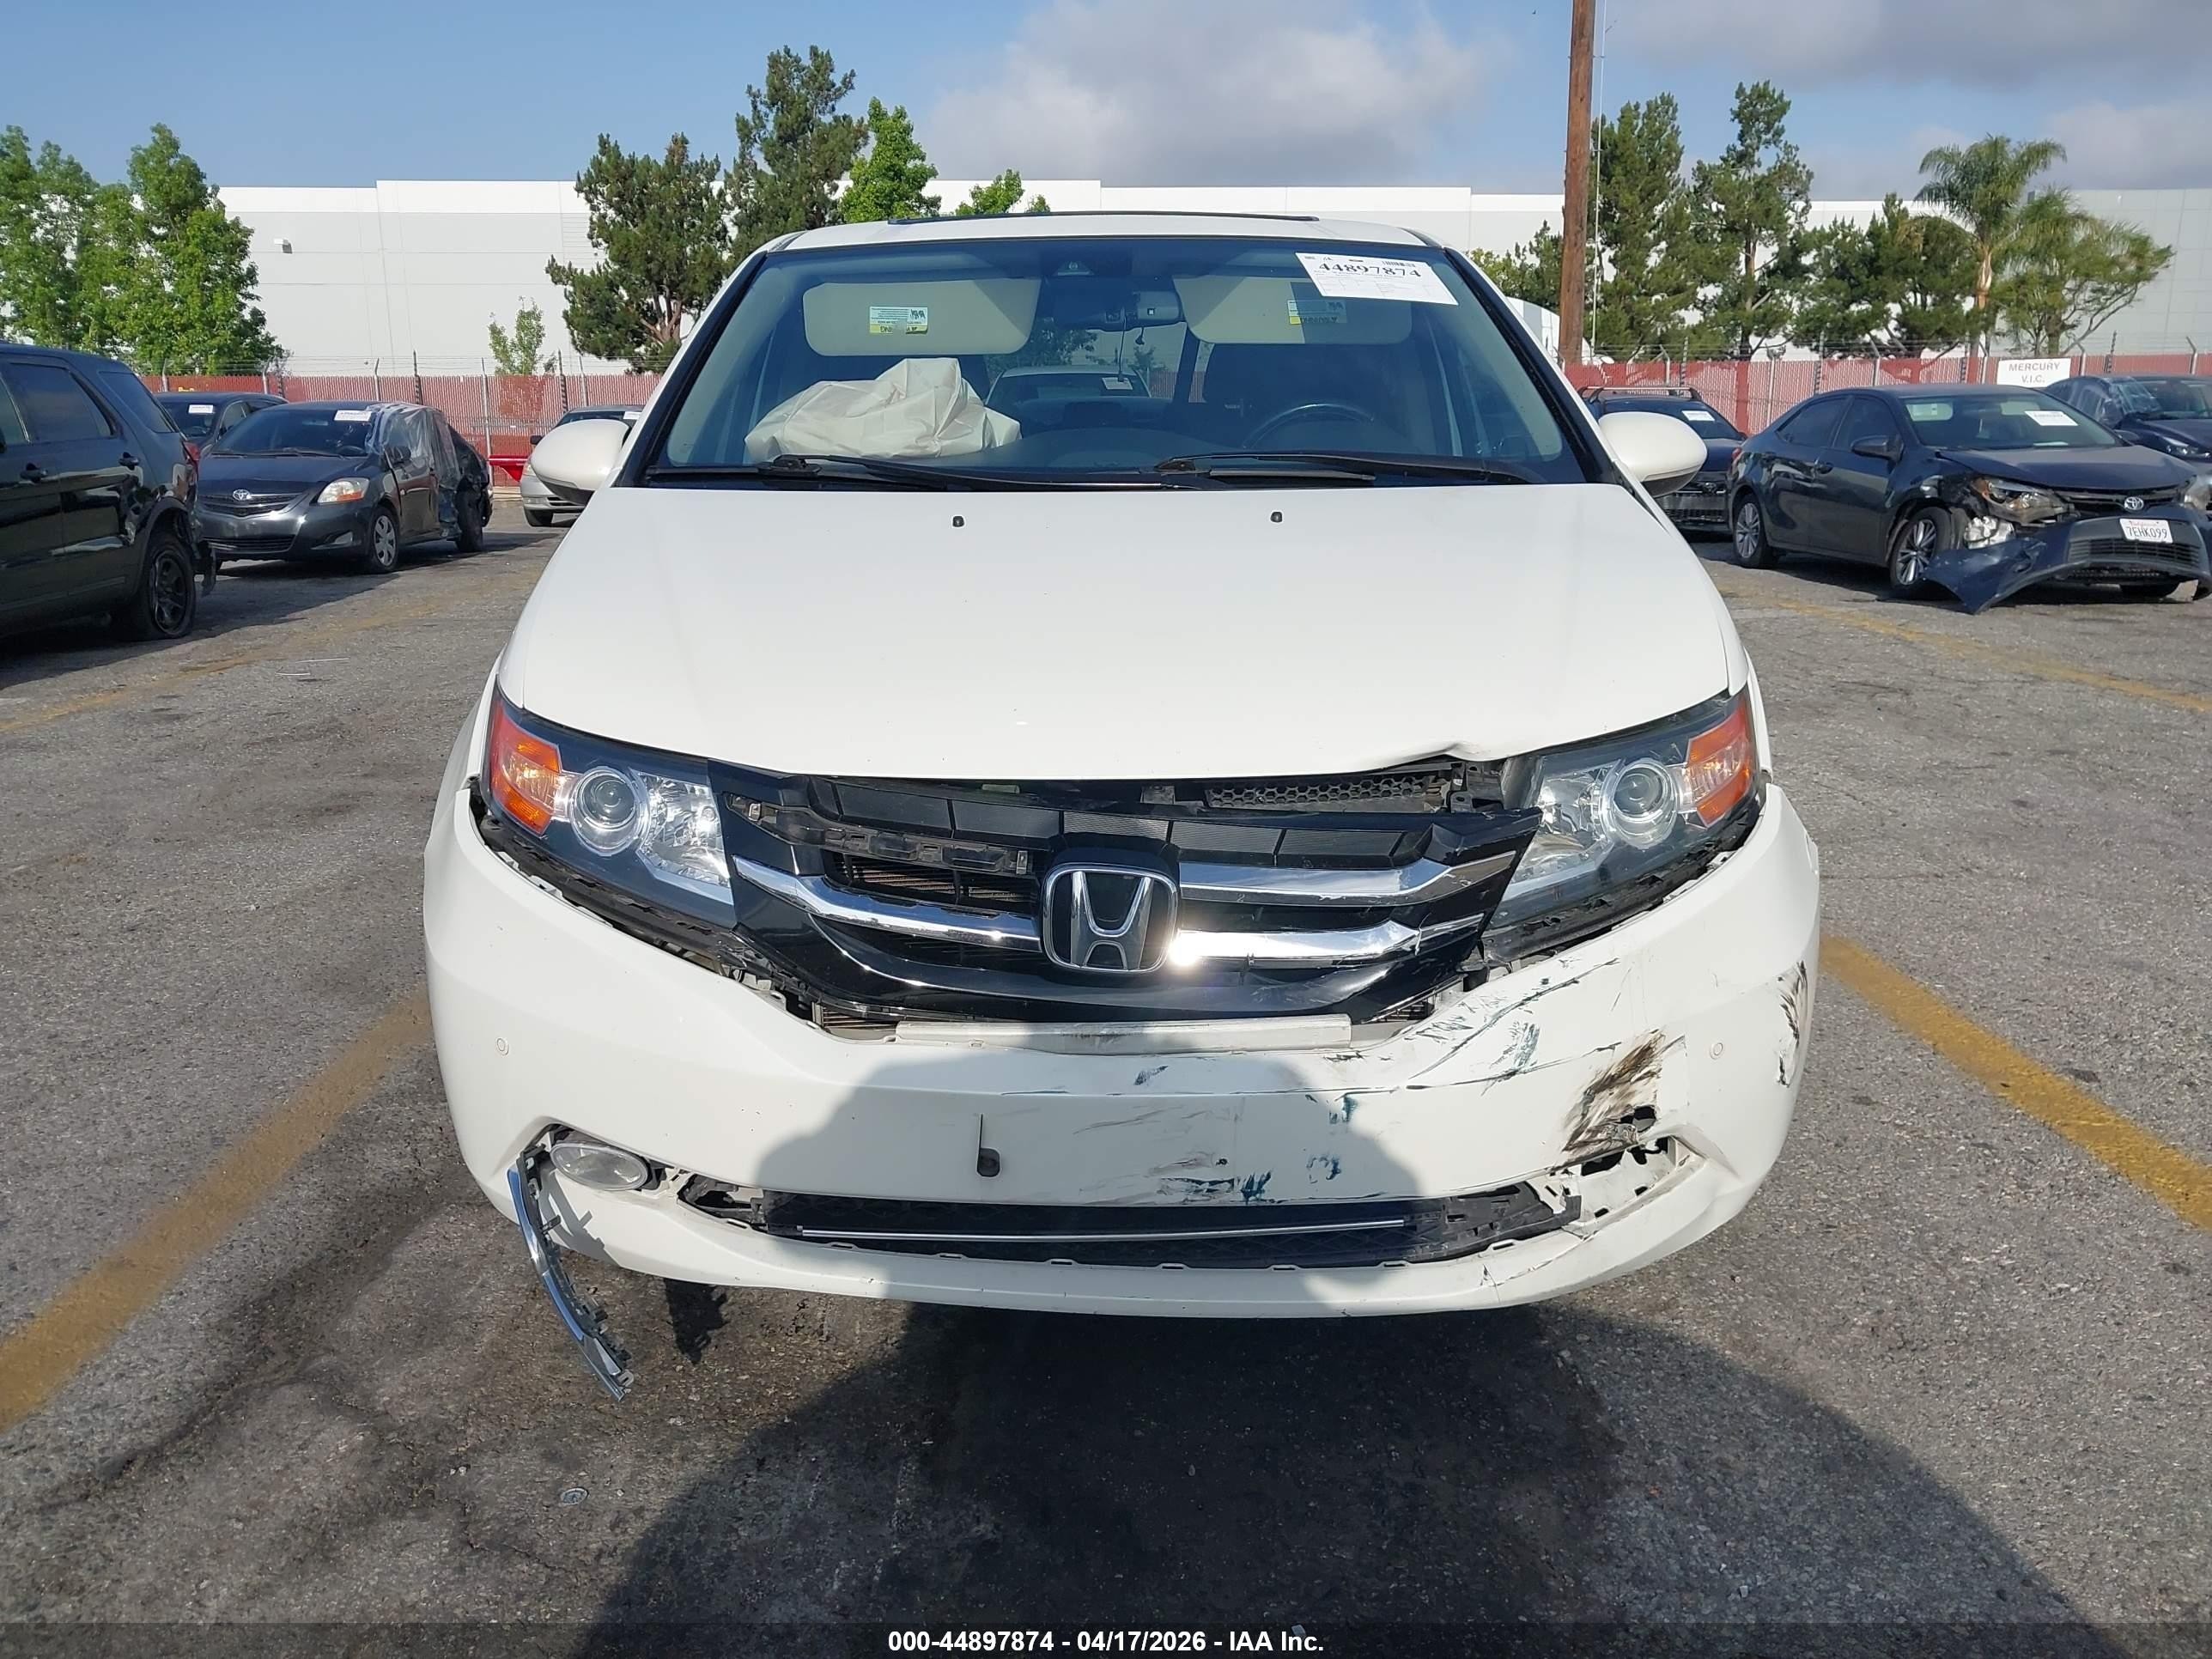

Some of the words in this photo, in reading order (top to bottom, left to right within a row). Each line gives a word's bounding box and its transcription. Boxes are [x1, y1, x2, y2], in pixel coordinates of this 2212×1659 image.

[1319, 263, 1421, 277] 44897874
[2008, 362, 2060, 372] MERCURY
[2021, 374, 2045, 383] V.I.C.
[2125, 526, 2167, 538] 7EHK099
